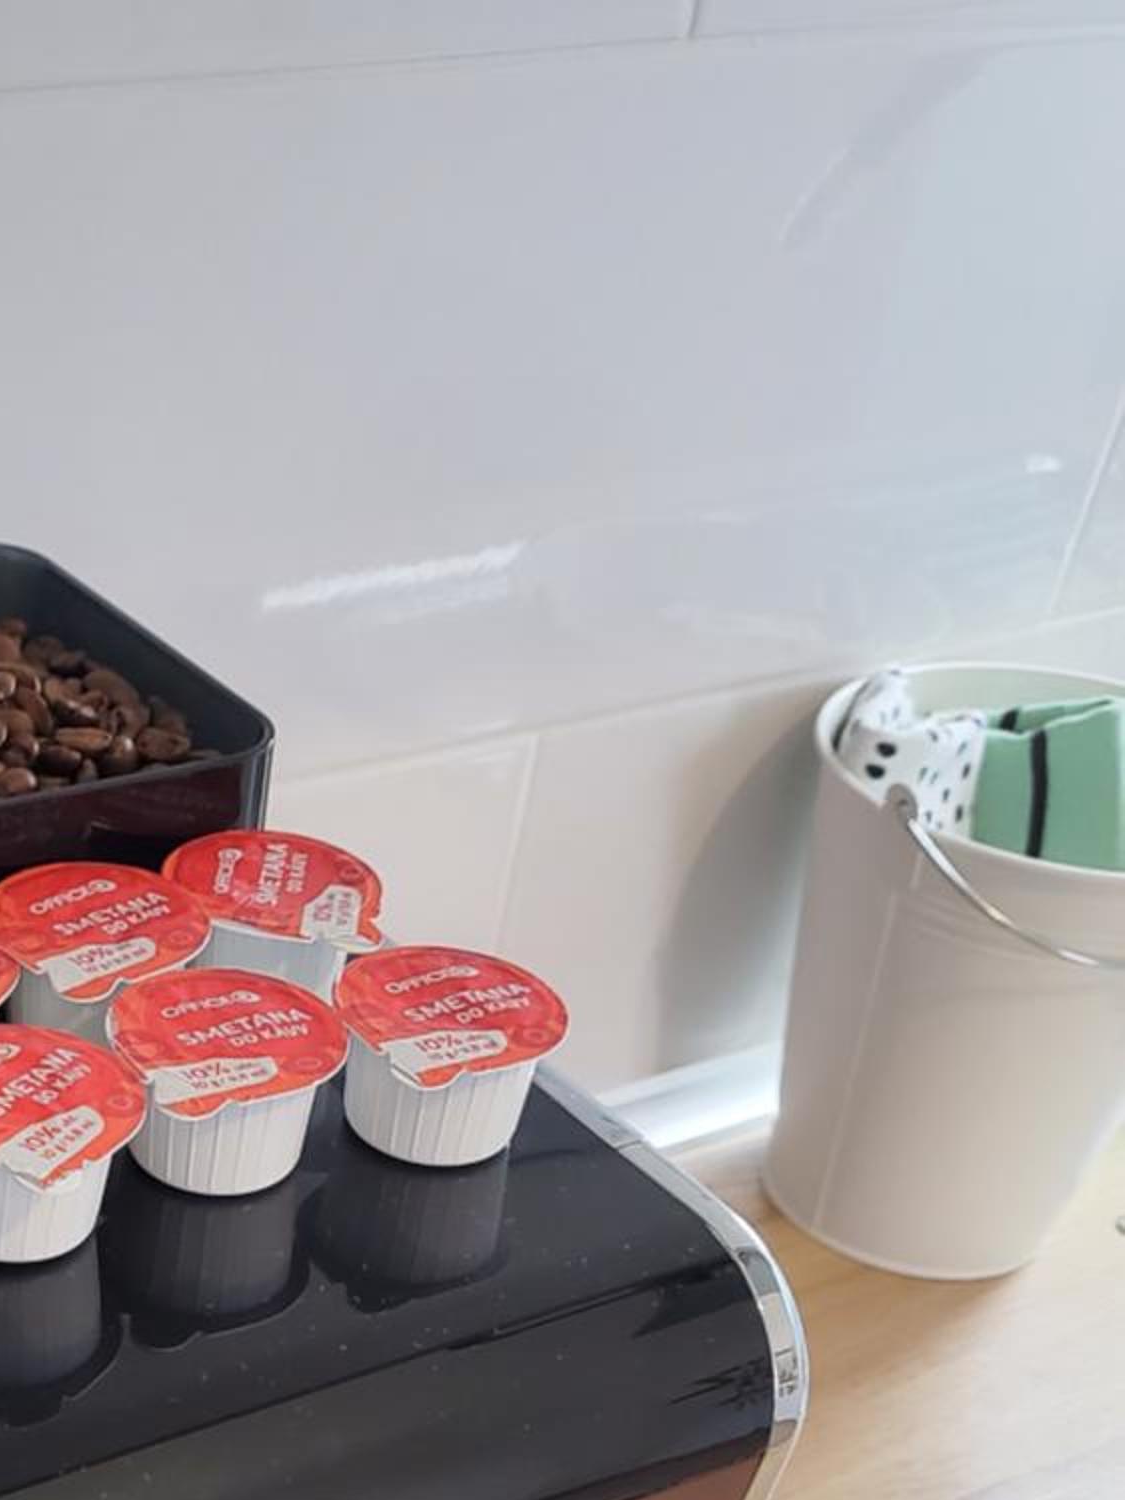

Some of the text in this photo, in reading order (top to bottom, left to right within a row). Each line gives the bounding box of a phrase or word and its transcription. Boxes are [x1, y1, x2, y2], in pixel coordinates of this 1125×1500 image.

[53, 892, 169, 936] SMETANA
[403, 983, 532, 1022] SMETANA
[456, 1007, 483, 1024] DO
[176, 1008, 312, 1046] SMETANA
[229, 1032, 259, 1048] DO
[415, 1034, 463, 1052] 10%
[183, 1062, 231, 1081] 10%
